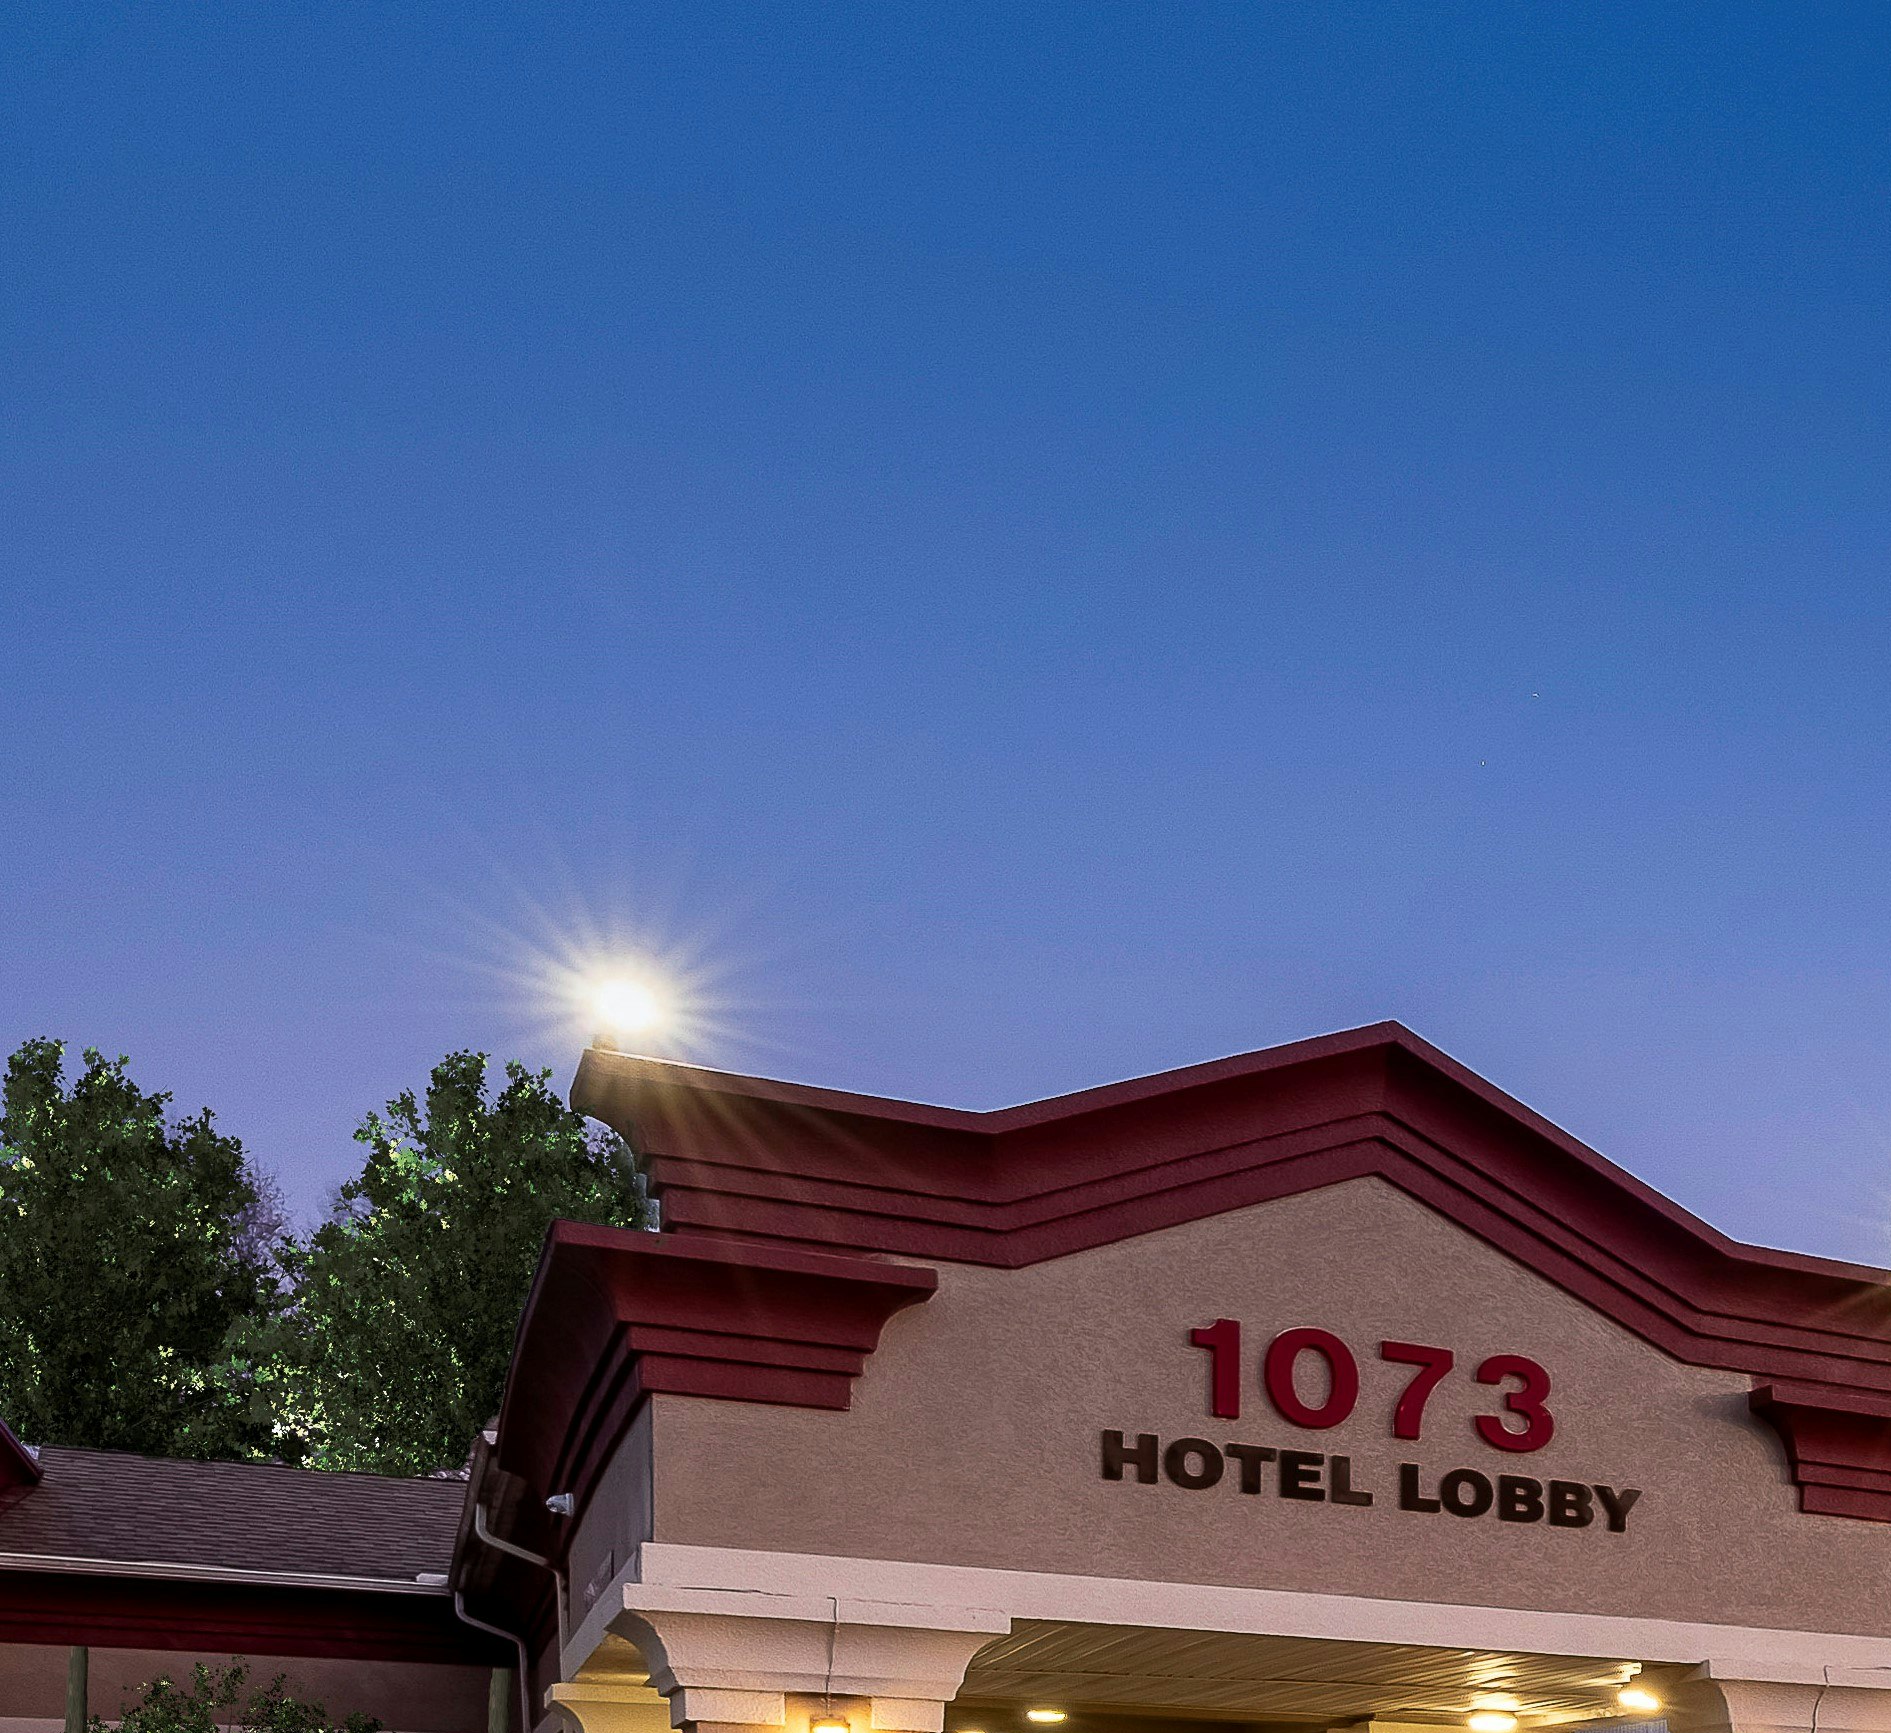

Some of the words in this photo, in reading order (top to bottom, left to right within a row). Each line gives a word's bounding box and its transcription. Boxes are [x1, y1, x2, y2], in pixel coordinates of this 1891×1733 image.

[1190, 1318, 1555, 1453] 1073
[1100, 1429, 1374, 1507] HOTEL
[1398, 1462, 1643, 1533] LOBBY
